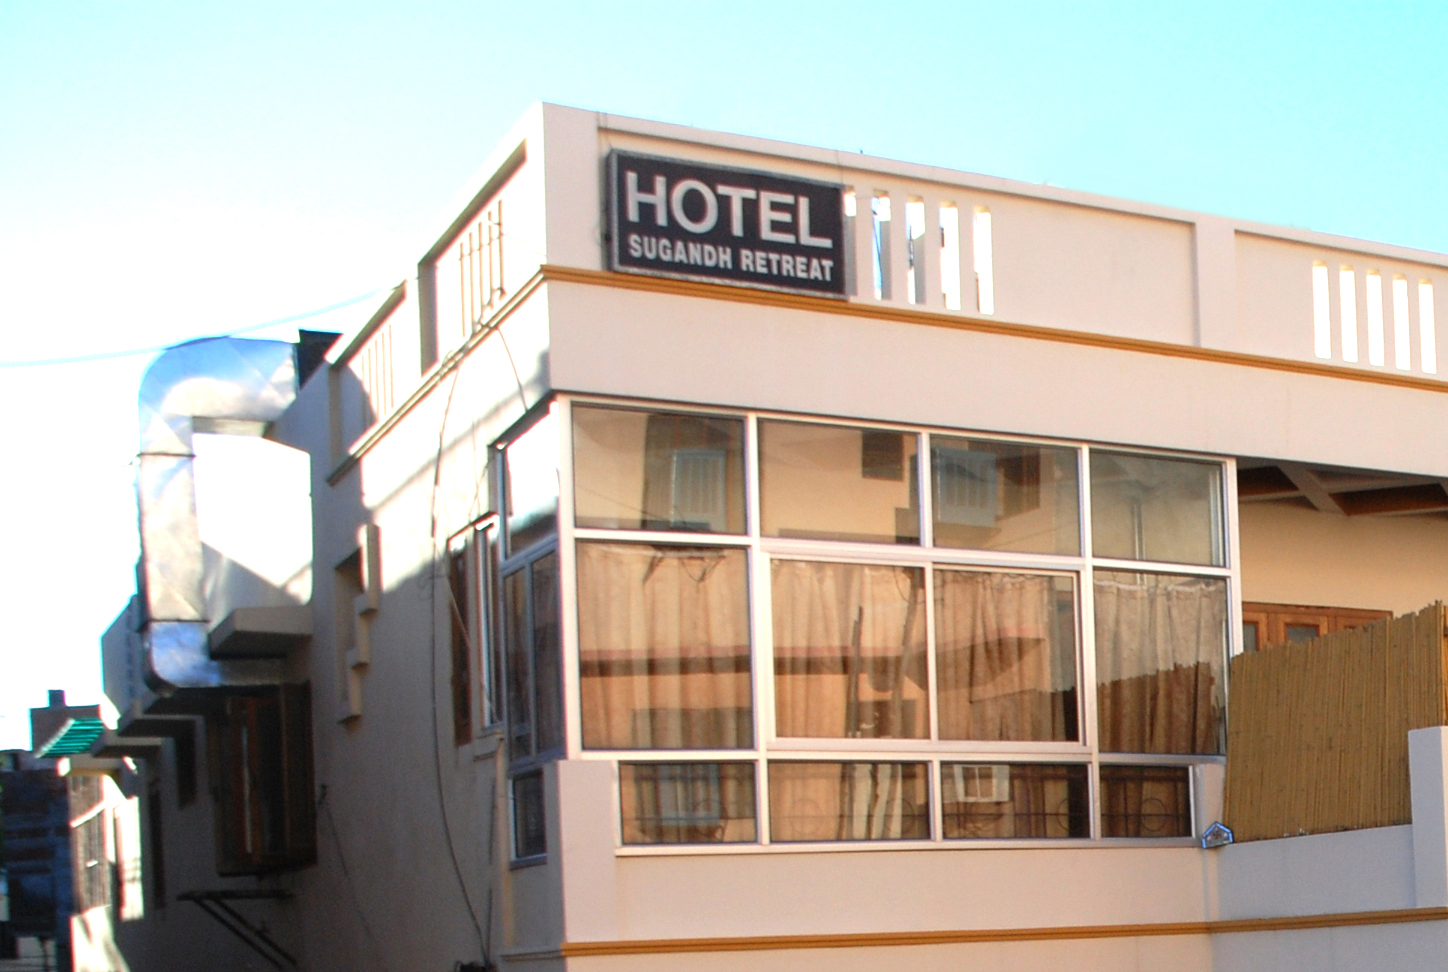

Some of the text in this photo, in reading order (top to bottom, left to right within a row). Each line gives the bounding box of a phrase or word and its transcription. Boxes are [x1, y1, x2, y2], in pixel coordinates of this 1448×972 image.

[624, 171, 833, 248] HOTEL
[628, 233, 834, 282] SUGANDH RETREAT
